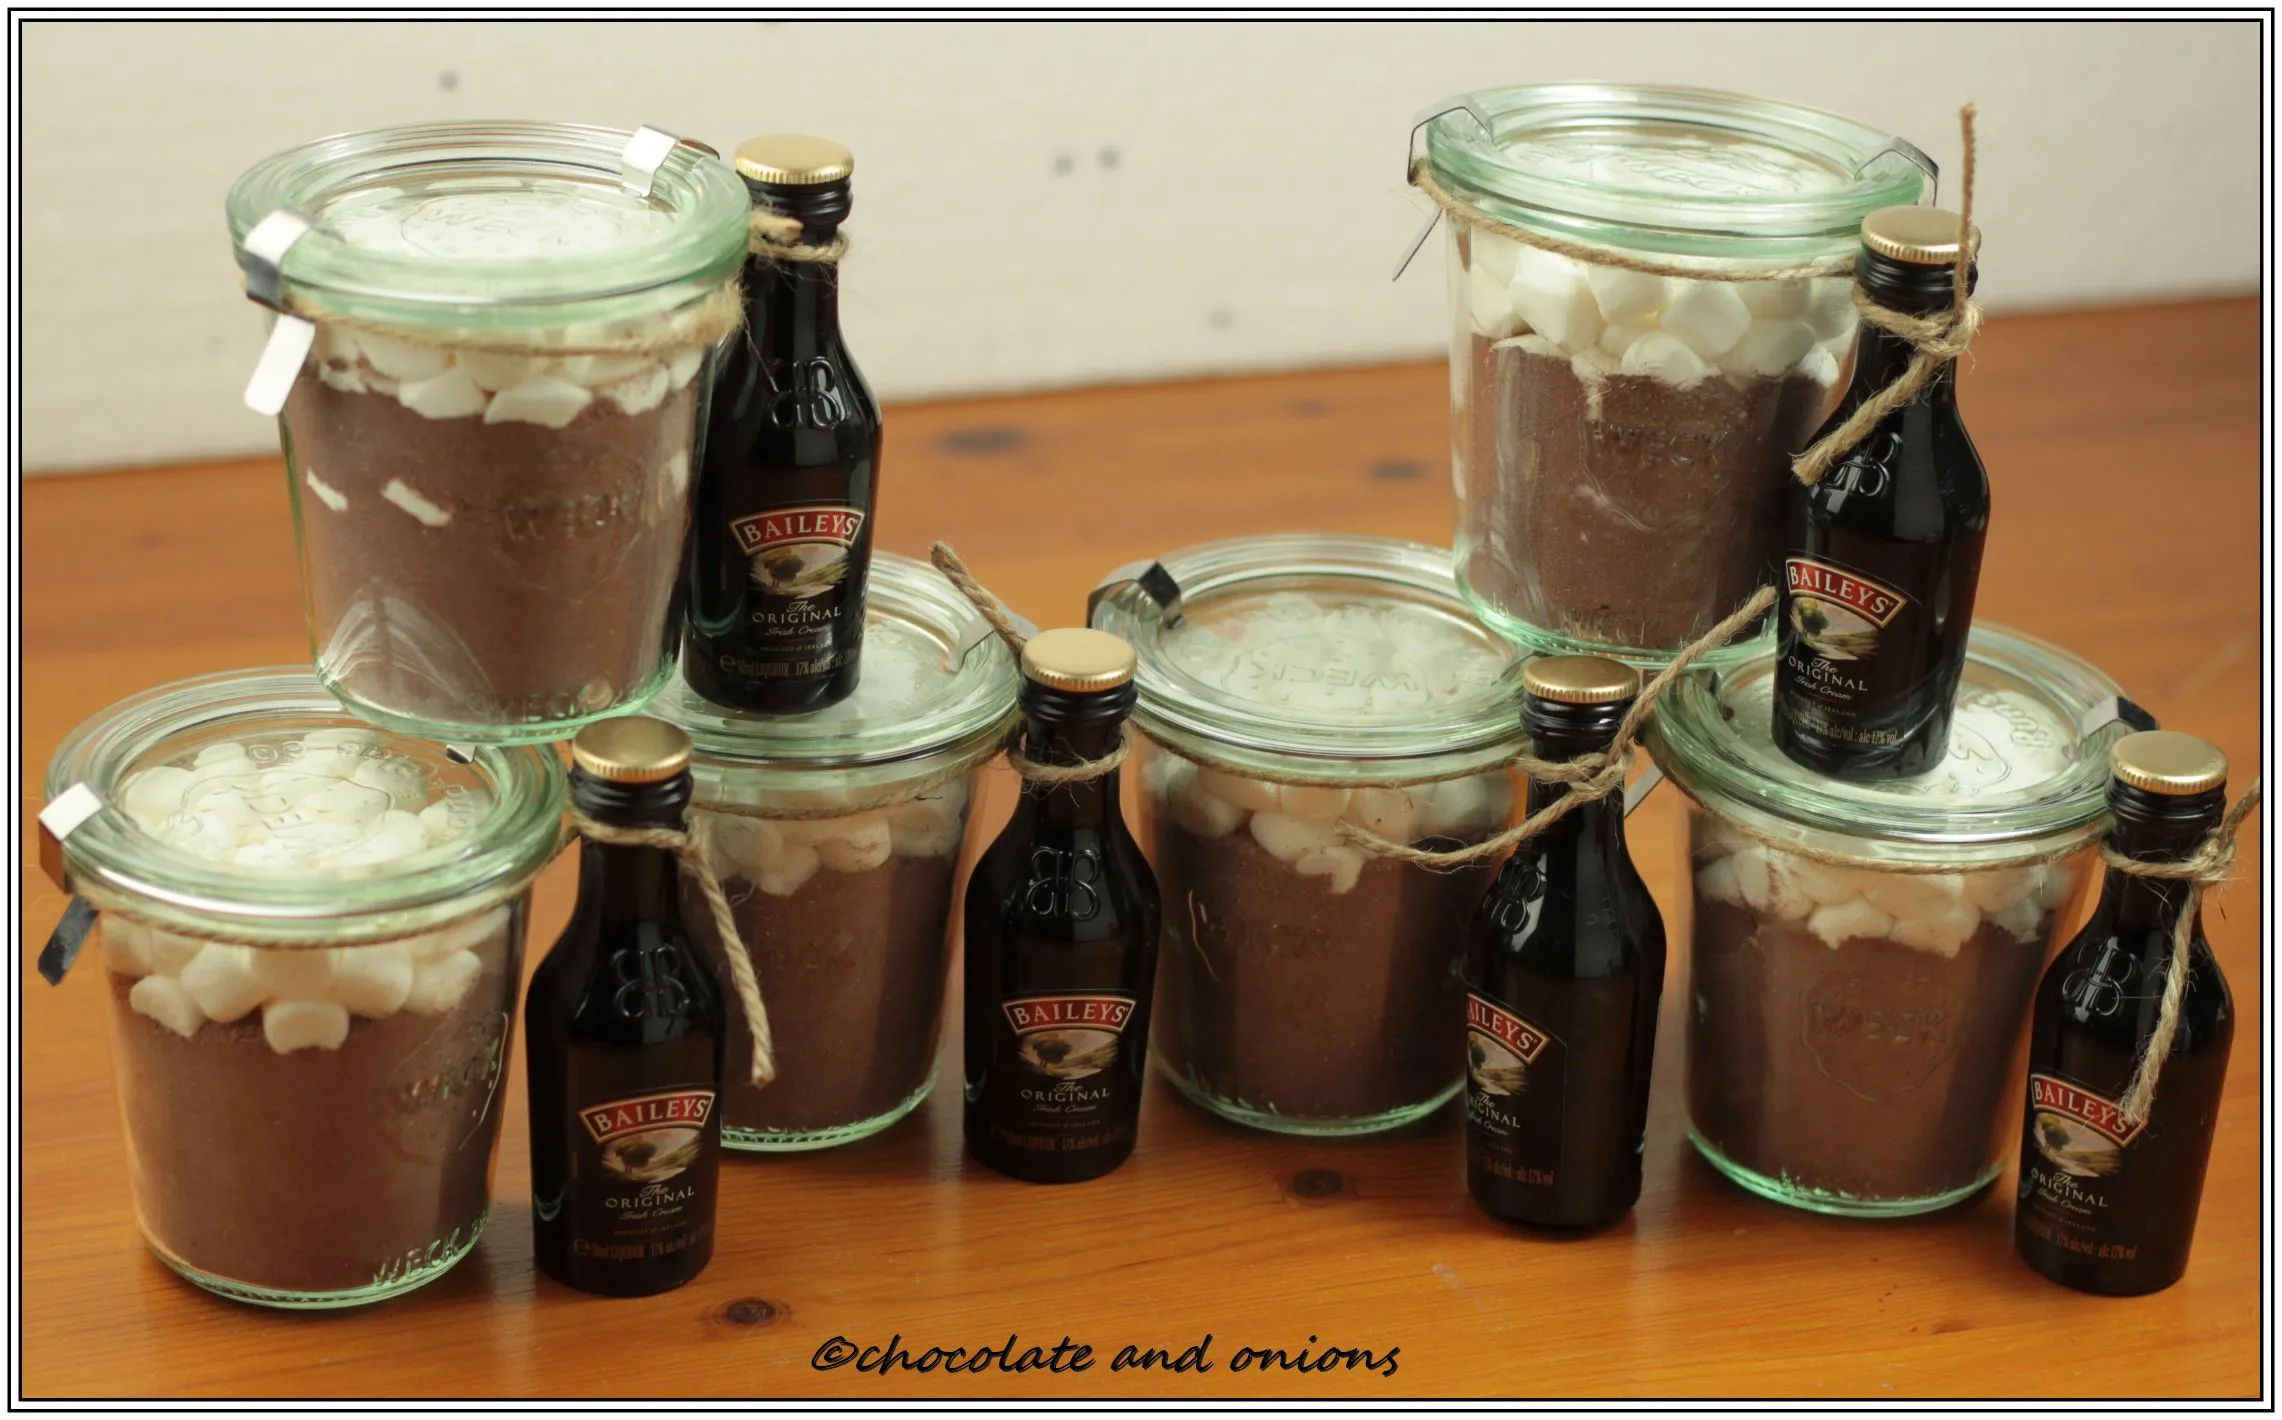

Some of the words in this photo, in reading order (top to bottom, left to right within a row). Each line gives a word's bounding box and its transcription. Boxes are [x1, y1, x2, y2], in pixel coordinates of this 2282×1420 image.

[742, 514, 857, 544] BAILEYS
[1789, 565, 1889, 614] BAILEYS
[752, 606, 842, 624] ORIGINAL
[786, 600, 816, 613] The
[1788, 655, 1868, 692] ORIGINAL
[1810, 657, 1837, 674] The
[1794, 674, 1817, 691] Irish
[1819, 685, 1852, 700] Cream
[1829, 724, 1854, 742] alc/vol
[1871, 731, 1886, 745] 17%
[1012, 1003, 1126, 1025] BAILEYS
[1467, 1001, 1534, 1050] AILEYS
[1021, 1087, 1110, 1102] ORIGINAL
[1053, 1081, 1083, 1092] The
[1476, 1092, 1496, 1108] The
[2034, 1081, 2133, 1134] BAILEYS
[593, 1099, 707, 1133] BAILEYS
[2031, 1168, 2109, 1208] ORIGINAL
[2053, 1171, 2079, 1188] The
[605, 1185, 695, 1209] ORIGINAL
[640, 1184, 669, 1198] The
[2060, 1199, 2092, 1215] Cream
